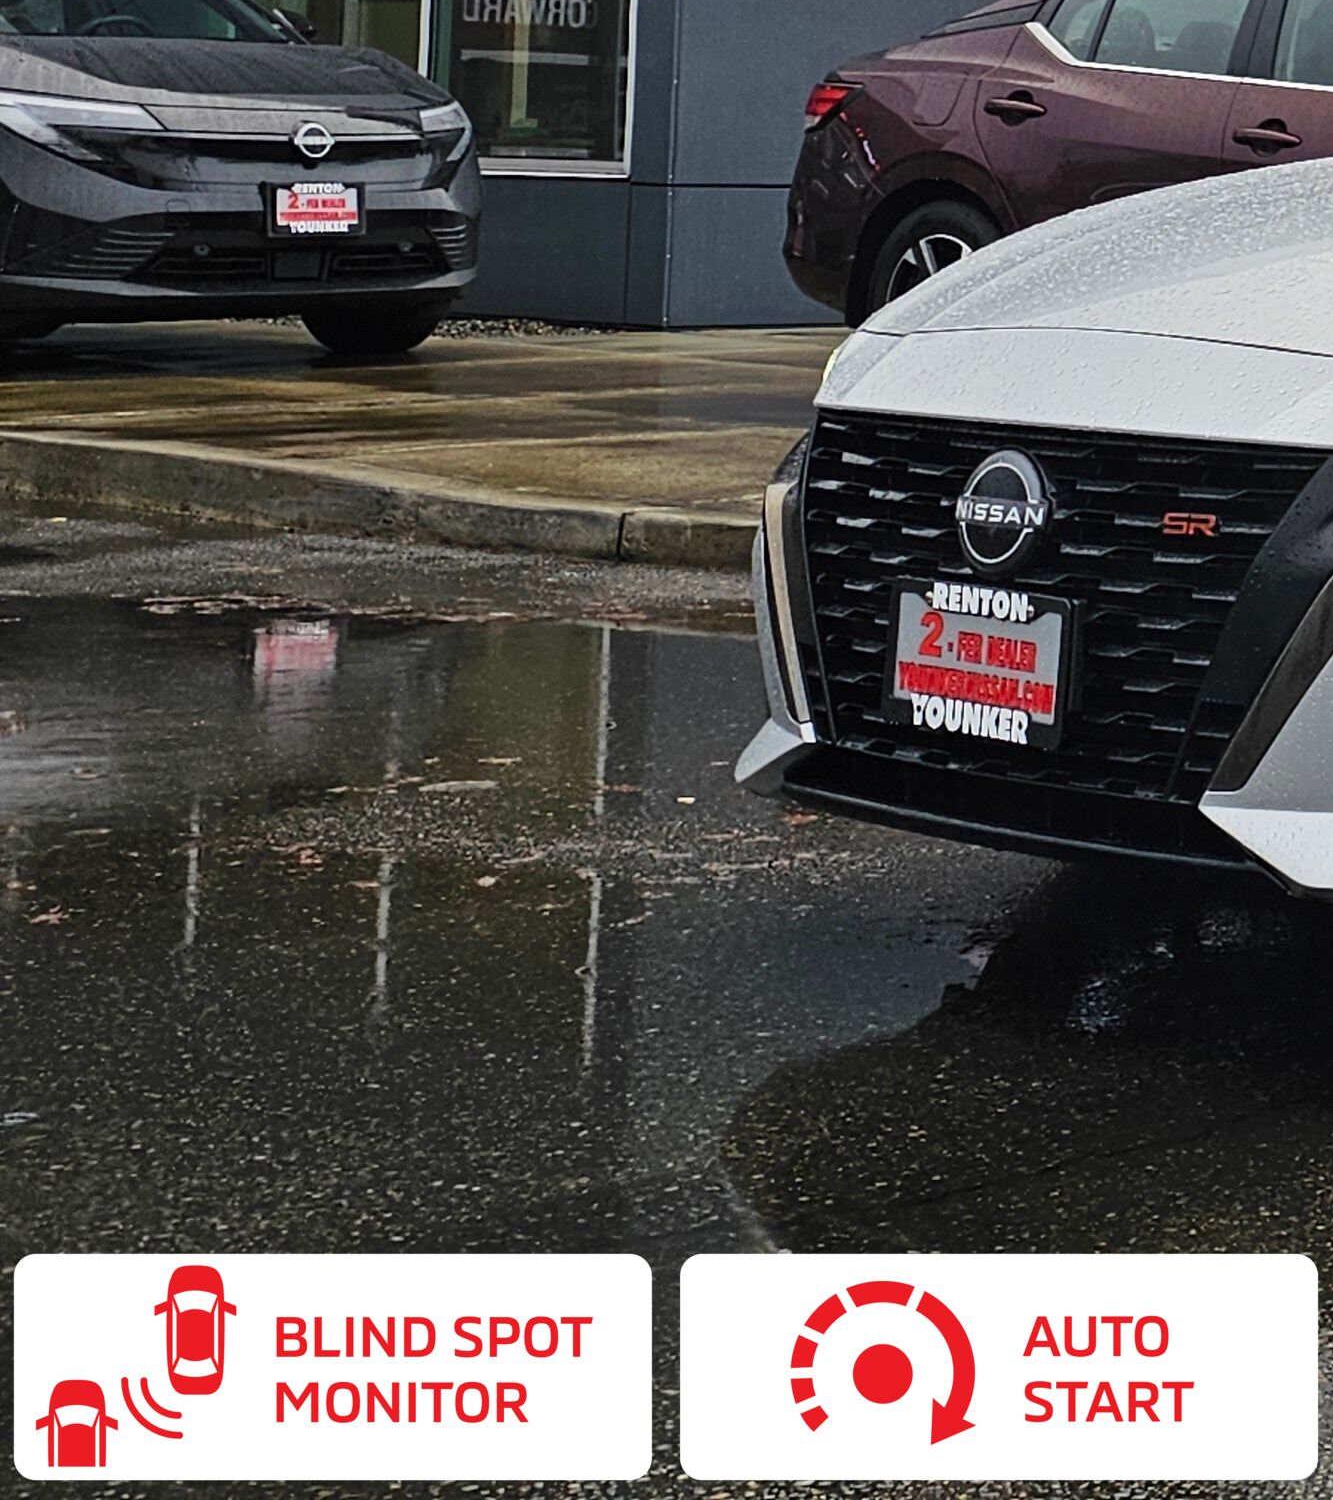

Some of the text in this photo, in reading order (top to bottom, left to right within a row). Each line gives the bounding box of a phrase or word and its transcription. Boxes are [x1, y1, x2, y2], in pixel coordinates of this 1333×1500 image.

[955, 501, 1046, 527] NISSAN
[1161, 512, 1218, 538] SR
[932, 581, 1029, 623] RENTON
[985, 635, 1037, 674] DEALER
[910, 693, 1029, 745] YOUNKER
